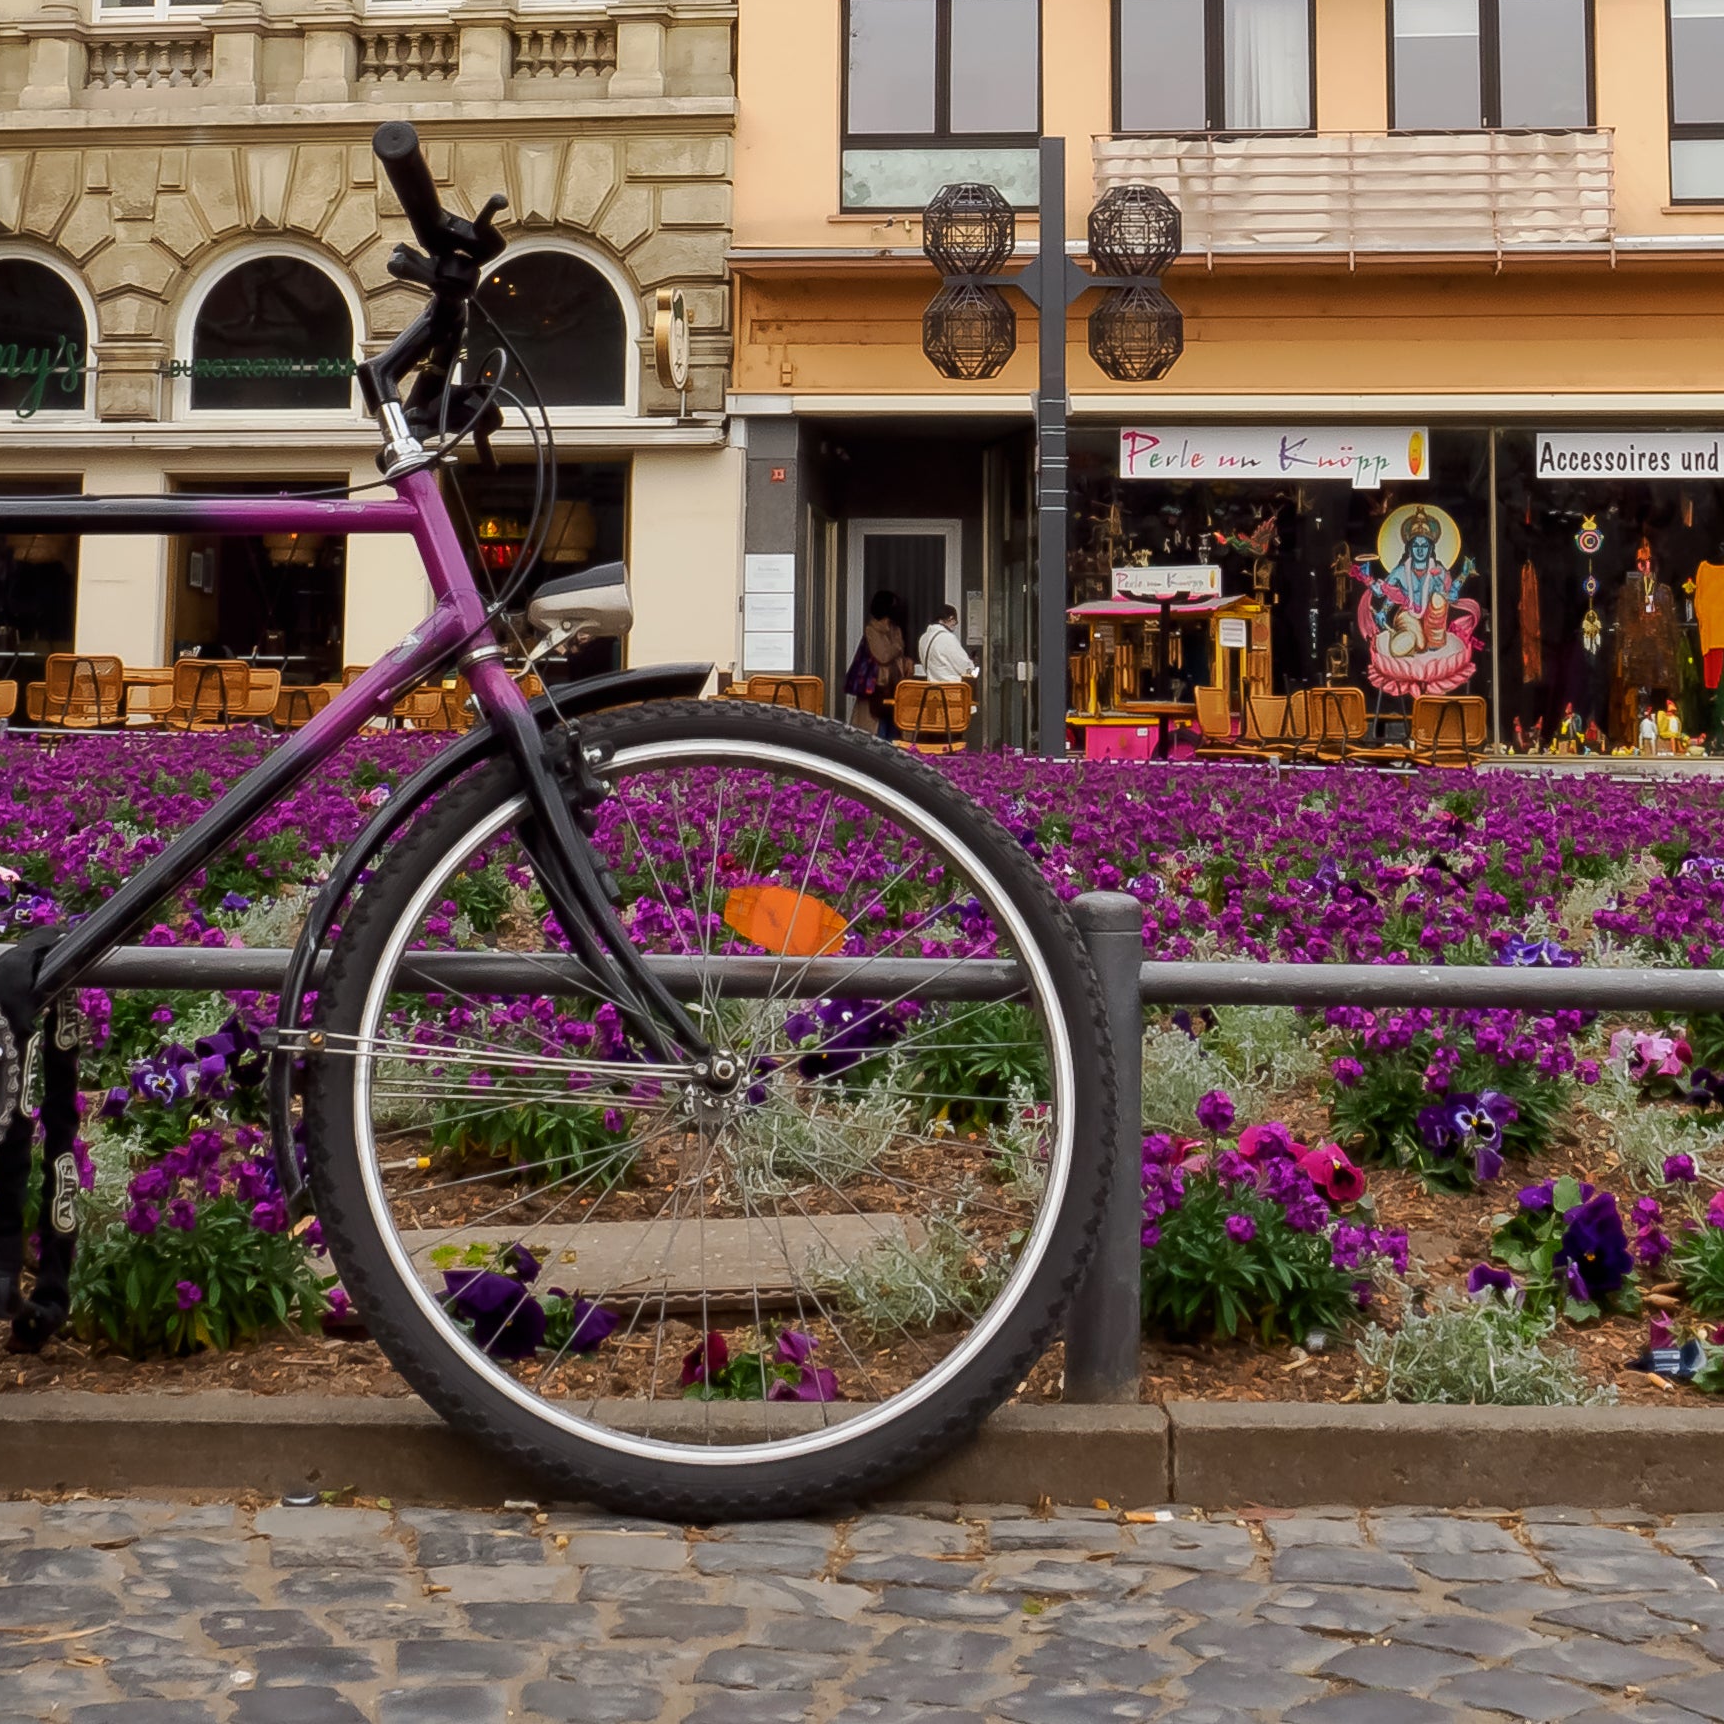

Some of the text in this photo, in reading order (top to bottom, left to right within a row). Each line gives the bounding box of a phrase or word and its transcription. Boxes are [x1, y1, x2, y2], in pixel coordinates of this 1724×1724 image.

[1121, 430, 1206, 476] Perle
[1278, 434, 1391, 486] Knöpp
[1538, 440, 1671, 474] Accessoires
[1680, 441, 1720, 473] und
[58, 1164, 77, 1221] ABUS
